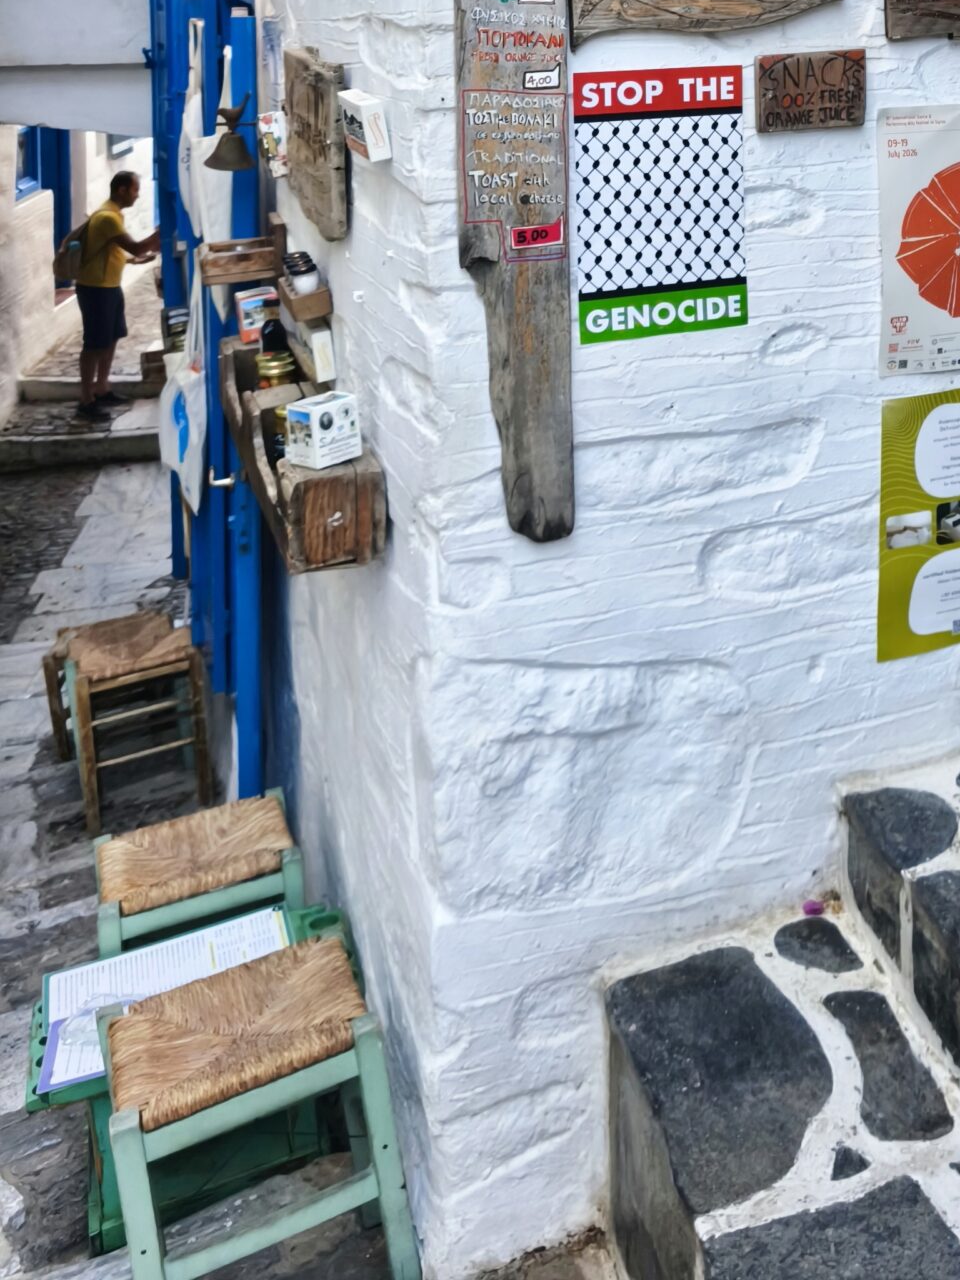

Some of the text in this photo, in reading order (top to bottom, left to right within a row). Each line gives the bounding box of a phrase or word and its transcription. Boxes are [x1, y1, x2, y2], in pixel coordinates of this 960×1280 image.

[768, 56, 862, 90] SNACKS
[581, 76, 735, 109] STOP THE
[819, 87, 862, 104] FRESH
[465, 108, 498, 127] ΤΟΣΤ
[765, 105, 857, 129] ORANGE JUICE
[887, 138, 909, 148] 09-19
[465, 149, 565, 166] TRADITIONAL
[468, 170, 519, 190] TOAST
[474, 190, 514, 209] local
[585, 294, 742, 334] GENOCIDE
